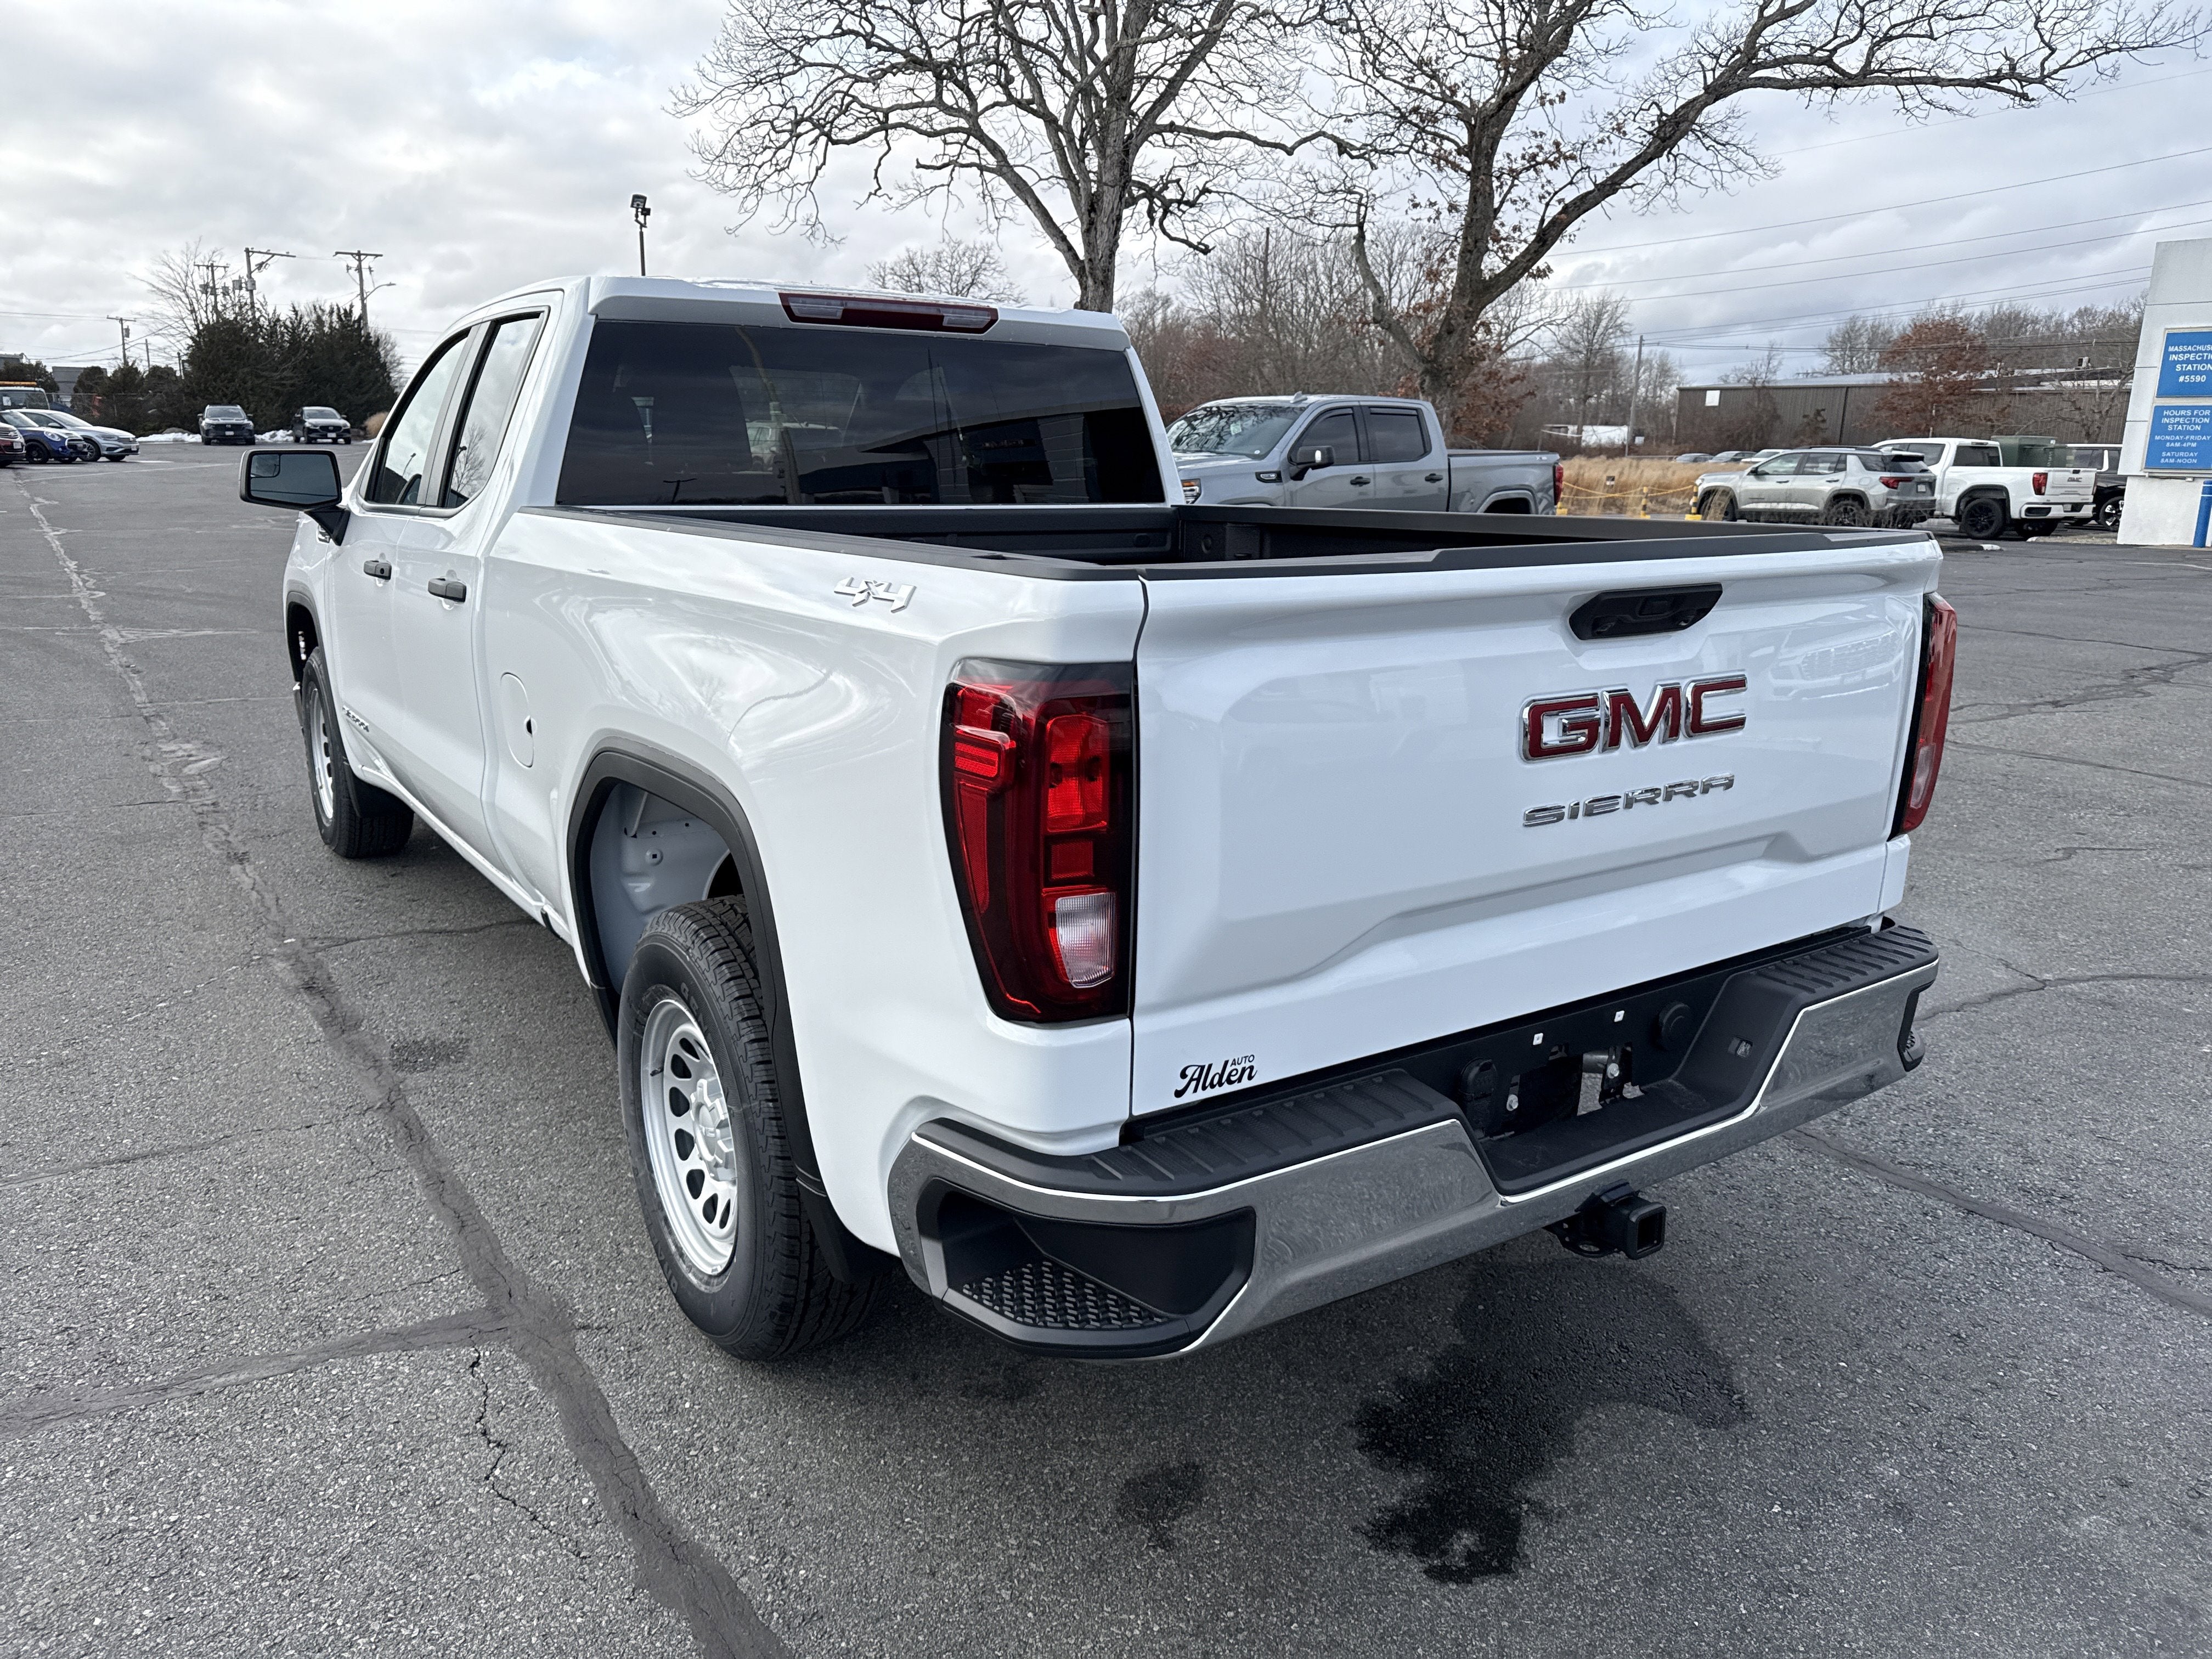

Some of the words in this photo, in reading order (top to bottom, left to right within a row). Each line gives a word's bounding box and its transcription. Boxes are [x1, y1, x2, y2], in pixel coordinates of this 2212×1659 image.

[2175, 363, 2212, 371] STATION
[1522, 674, 1748, 761] GMC
[1522, 773, 1735, 828] SIERRA
[1174, 1059, 1257, 1098] Alden
[1230, 1054, 1255, 1067] AUTO
